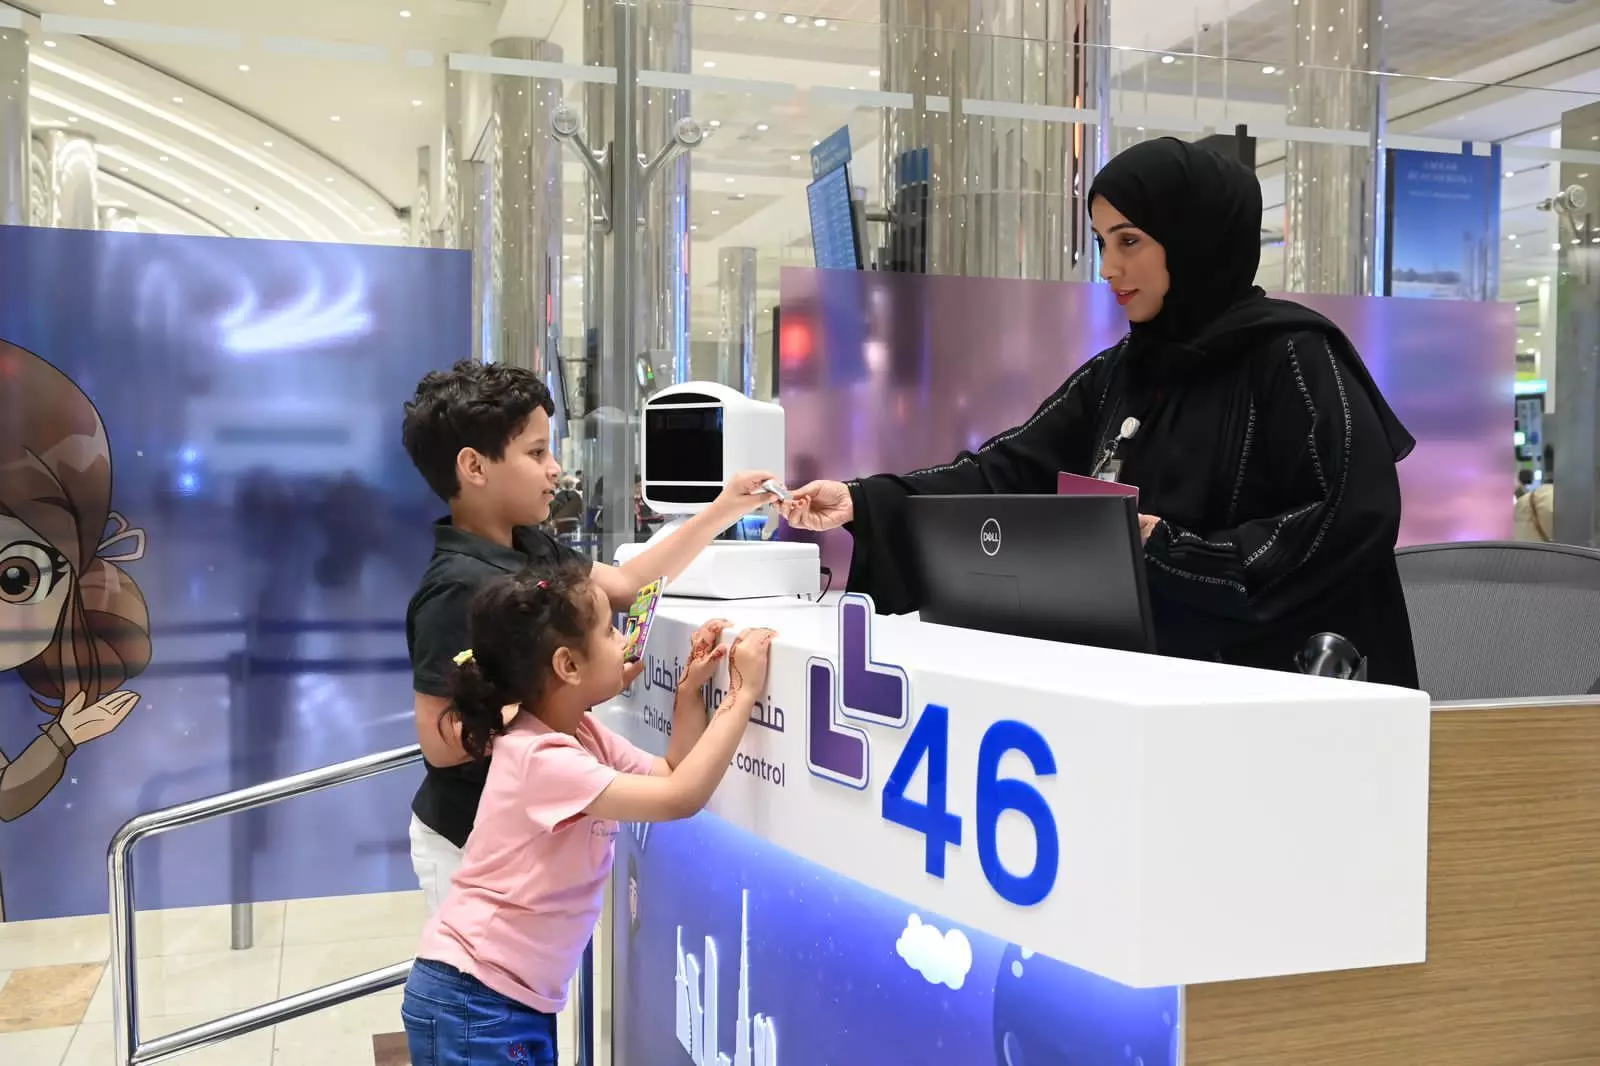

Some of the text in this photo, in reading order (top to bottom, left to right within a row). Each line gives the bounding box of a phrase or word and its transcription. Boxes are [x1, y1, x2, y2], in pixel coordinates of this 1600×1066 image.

[983, 531, 999, 542] DELL
[644, 654, 685, 692] لأطفال
[749, 695, 785, 733] منص
[643, 704, 785, 788] Childre control
[881, 703, 1060, 907] 46
